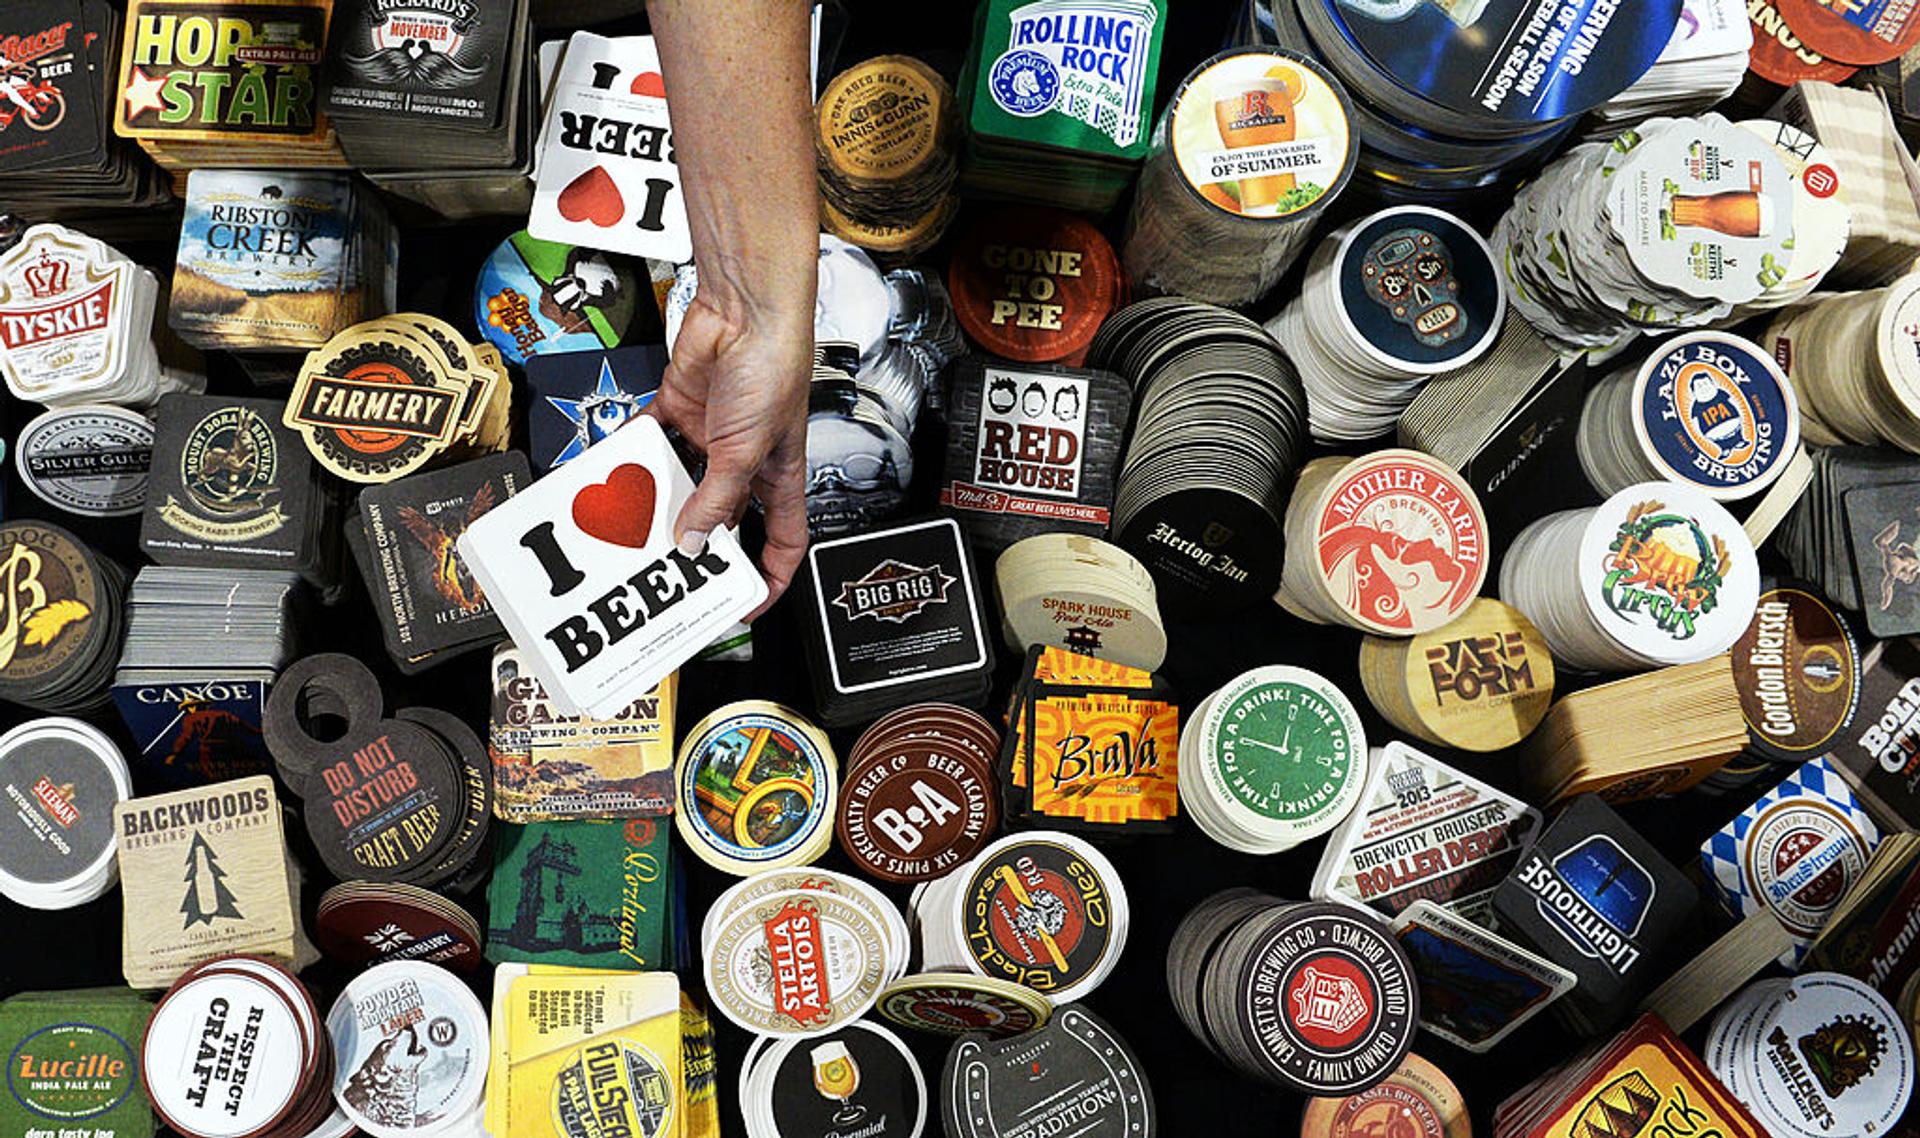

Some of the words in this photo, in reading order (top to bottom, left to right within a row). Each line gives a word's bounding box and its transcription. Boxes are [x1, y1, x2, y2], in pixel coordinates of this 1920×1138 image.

[134, 15, 250, 67] HOP
[390, 22, 449, 40] MOVEMBER
[1018, 15, 1133, 54] ROLLING
[41, 62, 73, 79] BEER
[240, 48, 269, 60] EXTRA
[272, 48, 296, 60] PALE
[298, 50, 317, 61] ALE
[1002, 54, 1047, 81] PREMIUM
[1061, 46, 1128, 86] ROCK
[1515, 26, 1566, 97] MOLSON
[1063, 73, 1093, 94] Extra
[1096, 82, 1124, 108] Pale
[1481, 45, 1530, 112] SEASON
[159, 71, 318, 126] STAR
[1211, 163, 1235, 178] OF
[1237, 153, 1322, 174] SUMMER.
[1212, 153, 1242, 163] ENJOY
[1245, 150, 1266, 159] THE
[1268, 144, 1316, 157] REWARDS
[211, 204, 319, 230] RIBSTONE
[636, 178, 674, 231] I
[206, 222, 319, 258] CREEK
[206, 250, 316, 268] BREWERY
[986, 244, 1082, 277] GONE
[1418, 261, 1442, 280] Sin
[1005, 274, 1055, 301] TO
[2, 295, 105, 344] TYSKIE
[992, 300, 1063, 331] PEE
[1658, 347, 1689, 421] LAZY
[1695, 345, 1752, 385] BOY
[312, 386, 442, 425] FARMERY
[1701, 402, 1731, 426] IPA
[187, 433, 206, 475] MOUNT
[203, 413, 238, 432] DORA
[250, 423, 272, 481] BREWING
[980, 420, 1079, 465] RED
[1693, 422, 1772, 482] BREWING
[31, 456, 98, 471] SILVER
[978, 461, 1075, 492] HOUSE
[169, 511, 204, 532] ROCKING
[369, 503, 389, 548] COMPANY
[1010, 500, 1034, 511] GREAT
[1035, 503, 1055, 515] BEER
[1332, 468, 1427, 521] MOTHER
[1431, 483, 1478, 564] EARTH
[1389, 499, 1446, 537] BREWING
[380, 548, 399, 592] BREWING
[520, 522, 586, 597] I
[1146, 522, 1215, 570] Hertog
[1214, 554, 1249, 583] Jan
[391, 592, 407, 626] NORTH
[545, 542, 731, 673] BEER
[854, 585, 892, 611] BIG
[896, 575, 934, 601] RIG
[1042, 597, 1086, 616] SPARK
[1088, 604, 1133, 621] HOUSE
[1749, 601, 1791, 666] Biersch
[136, 684, 253, 704] CANOE
[1234, 689, 1292, 722] DRINK!
[1300, 693, 1336, 727] TIME
[1754, 666, 1797, 737] Gordon
[510, 728, 578, 740] BREWING
[592, 723, 661, 736] COMPANY
[1226, 723, 1239, 736] A
[1330, 729, 1347, 762] FOR
[322, 759, 356, 797] DO
[353, 734, 397, 777] NOT
[1222, 740, 1239, 774] FOR
[1330, 766, 1343, 779] A
[33, 778, 79, 825] SLEEMAN
[332, 760, 418, 829] DISTURB
[854, 765, 890, 799] BEER
[927, 753, 966, 780] BEER
[960, 777, 986, 841] ACADEMY
[1232, 776, 1269, 810] TIME
[1278, 781, 1335, 814] DRINK!
[1397, 786, 1432, 809] 2013
[5, 783, 54, 835] NOTORIOUSLY
[48, 829, 72, 856] GOOD
[122, 787, 270, 838] BACKWOODS
[126, 828, 187, 851] BREWING
[206, 814, 270, 837] COMPANY
[353, 826, 410, 869] CRAFT
[400, 803, 441, 853] BEER
[847, 800, 887, 867] SPECIALTY
[1353, 831, 1429, 872] BREWCITY
[1433, 805, 1508, 843] BRUISERS
[886, 859, 931, 875] PINTS
[933, 848, 960, 870] SIX
[1354, 846, 1449, 900] ROLLER
[1066, 860, 1106, 927] Ales
[1517, 856, 1641, 974] LIGHTHOUSE
[1295, 926, 1317, 949] CO
[1332, 924, 1385, 964] BREWED
[772, 919, 801, 1012] STELLA
[791, 915, 821, 1009] ARTOIS
[1255, 936, 1299, 993] BREWING
[356, 977, 420, 1014] POWDER
[528, 989, 538, 1001] to
[560, 989, 571, 1007] But
[573, 989, 583, 1001] to
[1375, 959, 1407, 1016] QUALITY
[361, 992, 425, 1031] MOUNTAIN
[379, 1007, 426, 1037] LAGER
[538, 989, 549, 1035] addicted
[549, 989, 560, 1030] Steam's
[583, 989, 594, 1035] addicted
[435, 1024, 450, 1040] W
[1254, 994, 1297, 1065] EMMETT'S
[19, 1054, 125, 1078] Lucille
[186, 996, 231, 1109] CRAFT
[214, 1032, 240, 1082] THE
[224, 1004, 265, 1117] RESPECT
[1306, 1059, 1354, 1082] FAMILY
[1353, 1030, 1397, 1075] OWNED
[31, 1081, 61, 1090] INDIA
[65, 1081, 89, 1090] PALE
[93, 1081, 112, 1090] ALE
[1765, 1048, 1792, 1084] IRISH
[1786, 1082, 1814, 1122] LAGER
[1348, 1087, 1393, 1111] CASSEL
[1394, 1088, 1440, 1137] BREWERY
